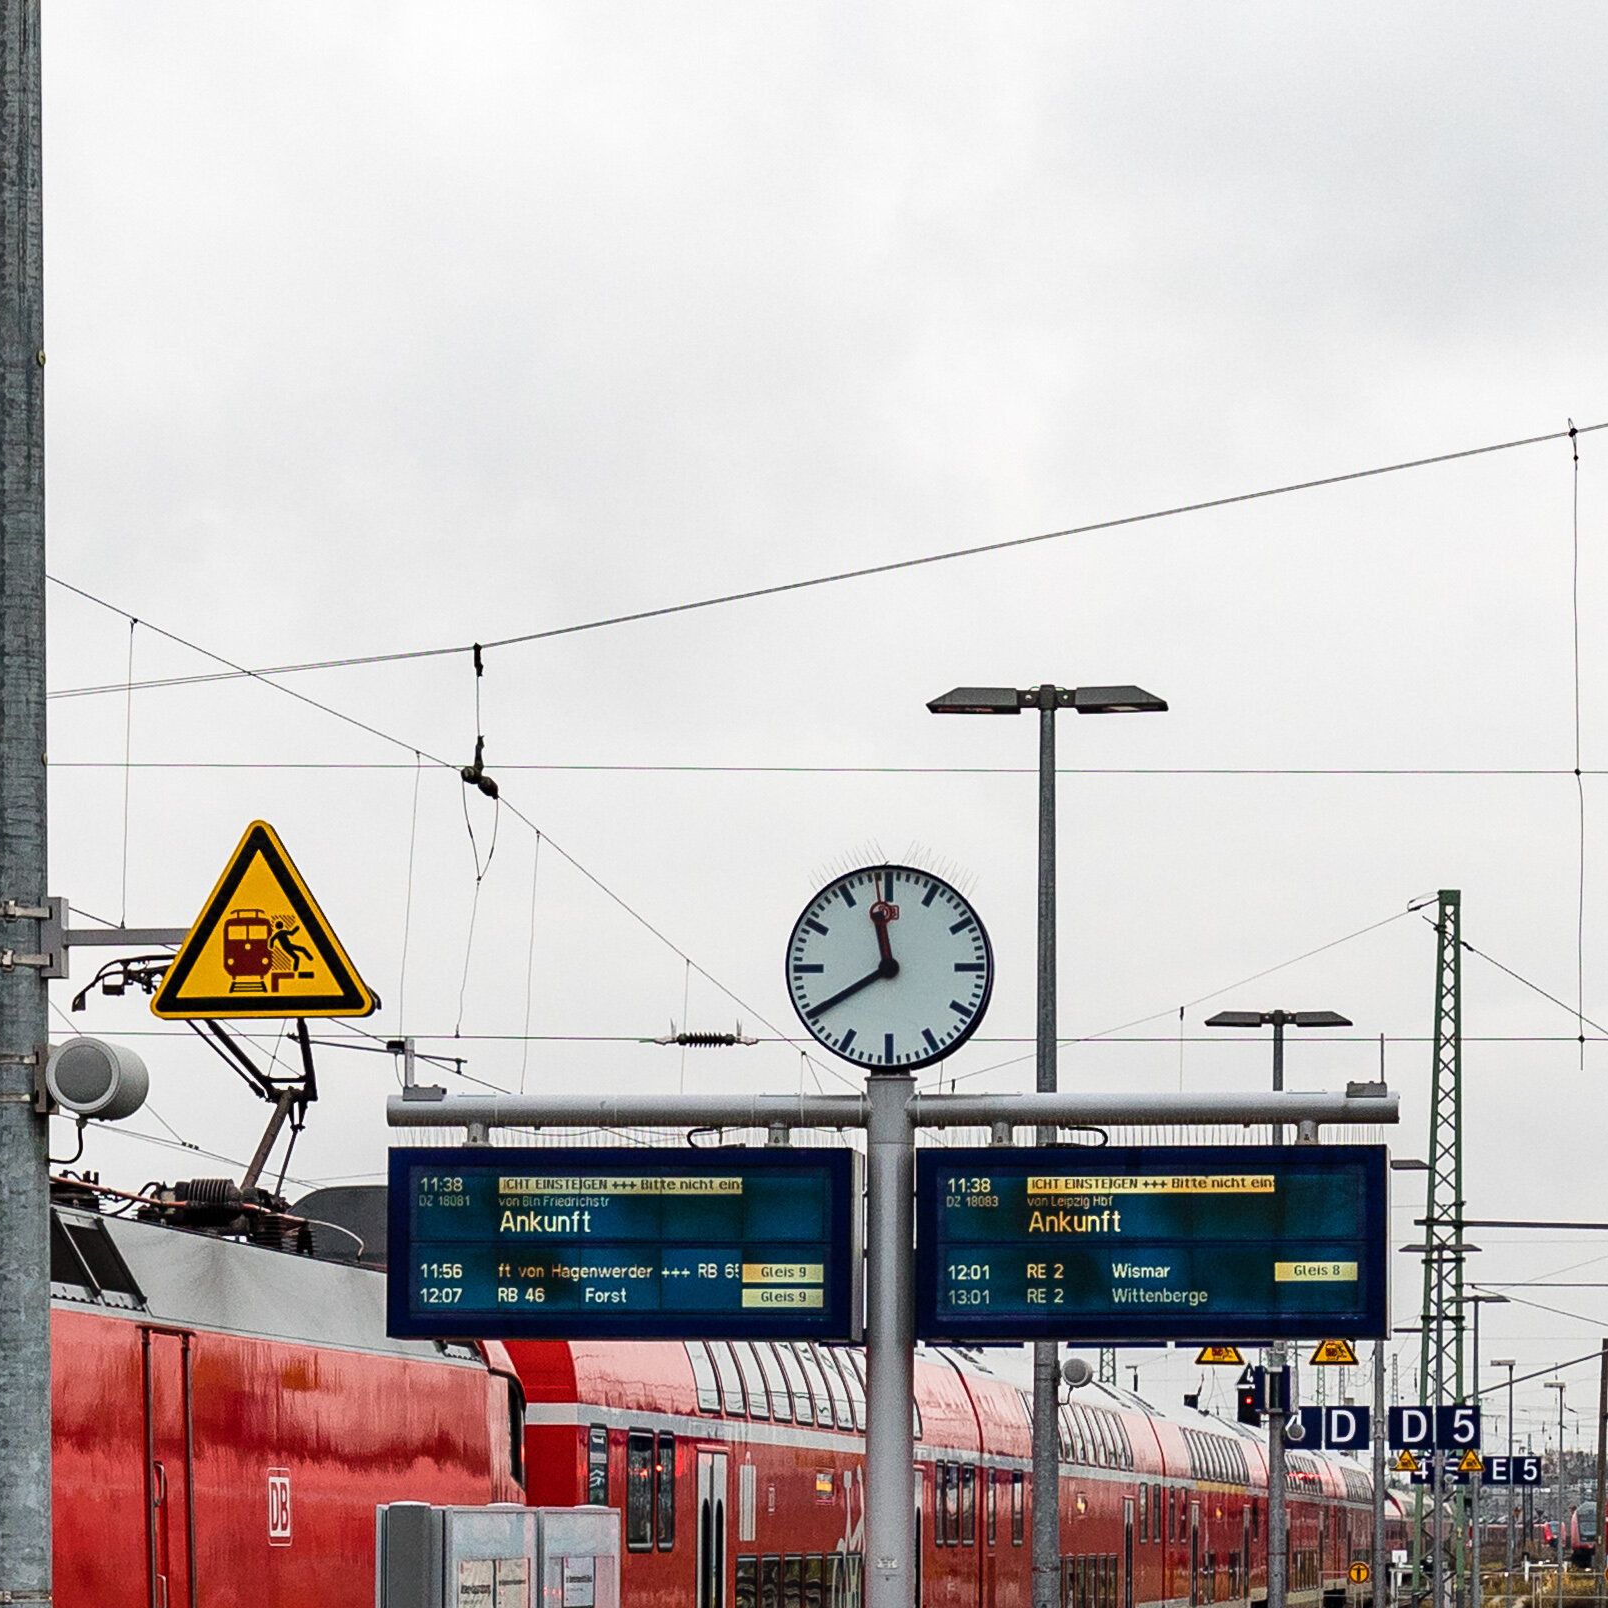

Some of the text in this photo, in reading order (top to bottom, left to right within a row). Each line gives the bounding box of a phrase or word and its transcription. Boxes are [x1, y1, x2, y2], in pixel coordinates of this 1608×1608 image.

[420, 1177, 463, 1193] 11:38
[535, 1178, 608, 1190] EINSTEIGEN
[640, 1178, 676, 1190] Bitte
[679, 1178, 714, 1190] nicht
[947, 1177, 991, 1193] 11:38
[1064, 1178, 1138, 1190] EINSTEIGEN
[1171, 1177, 1208, 1189] Bitte
[1211, 1176, 1247, 1188] nicht
[498, 1198, 521, 1207] von
[966, 1196, 999, 1208] 18083
[1027, 1195, 1114, 1210] von Leipzig Hbf
[499, 1210, 592, 1233] Ankunft
[1028, 1210, 1122, 1233] Ankunft
[420, 1263, 463, 1279] 11:56
[518, 1266, 545, 1279] von
[551, 1263, 654, 1282] Hagenwerder
[697, 1263, 718, 1279] RB
[760, 1266, 807, 1278] Gleis 9
[947, 1264, 990, 1280] 12:01
[1026, 1263, 1065, 1279] RE 2
[1111, 1262, 1171, 1279] Wismar
[1293, 1264, 1341, 1276] Gleis 8
[419, 1287, 463, 1303] 12:07
[497, 1287, 546, 1303] RB 46
[585, 1287, 627, 1303] Forst
[760, 1291, 807, 1303] Gleis 9
[947, 1289, 990, 1305] 13:01
[1026, 1288, 1065, 1304] RE 2
[1111, 1288, 1209, 1307] Wittenberge
[1330, 1409, 1357, 1443] D
[1402, 1409, 1475, 1443] D 5
[1492, 1458, 1537, 1481] E 5
[270, 1482, 289, 1532] DB
